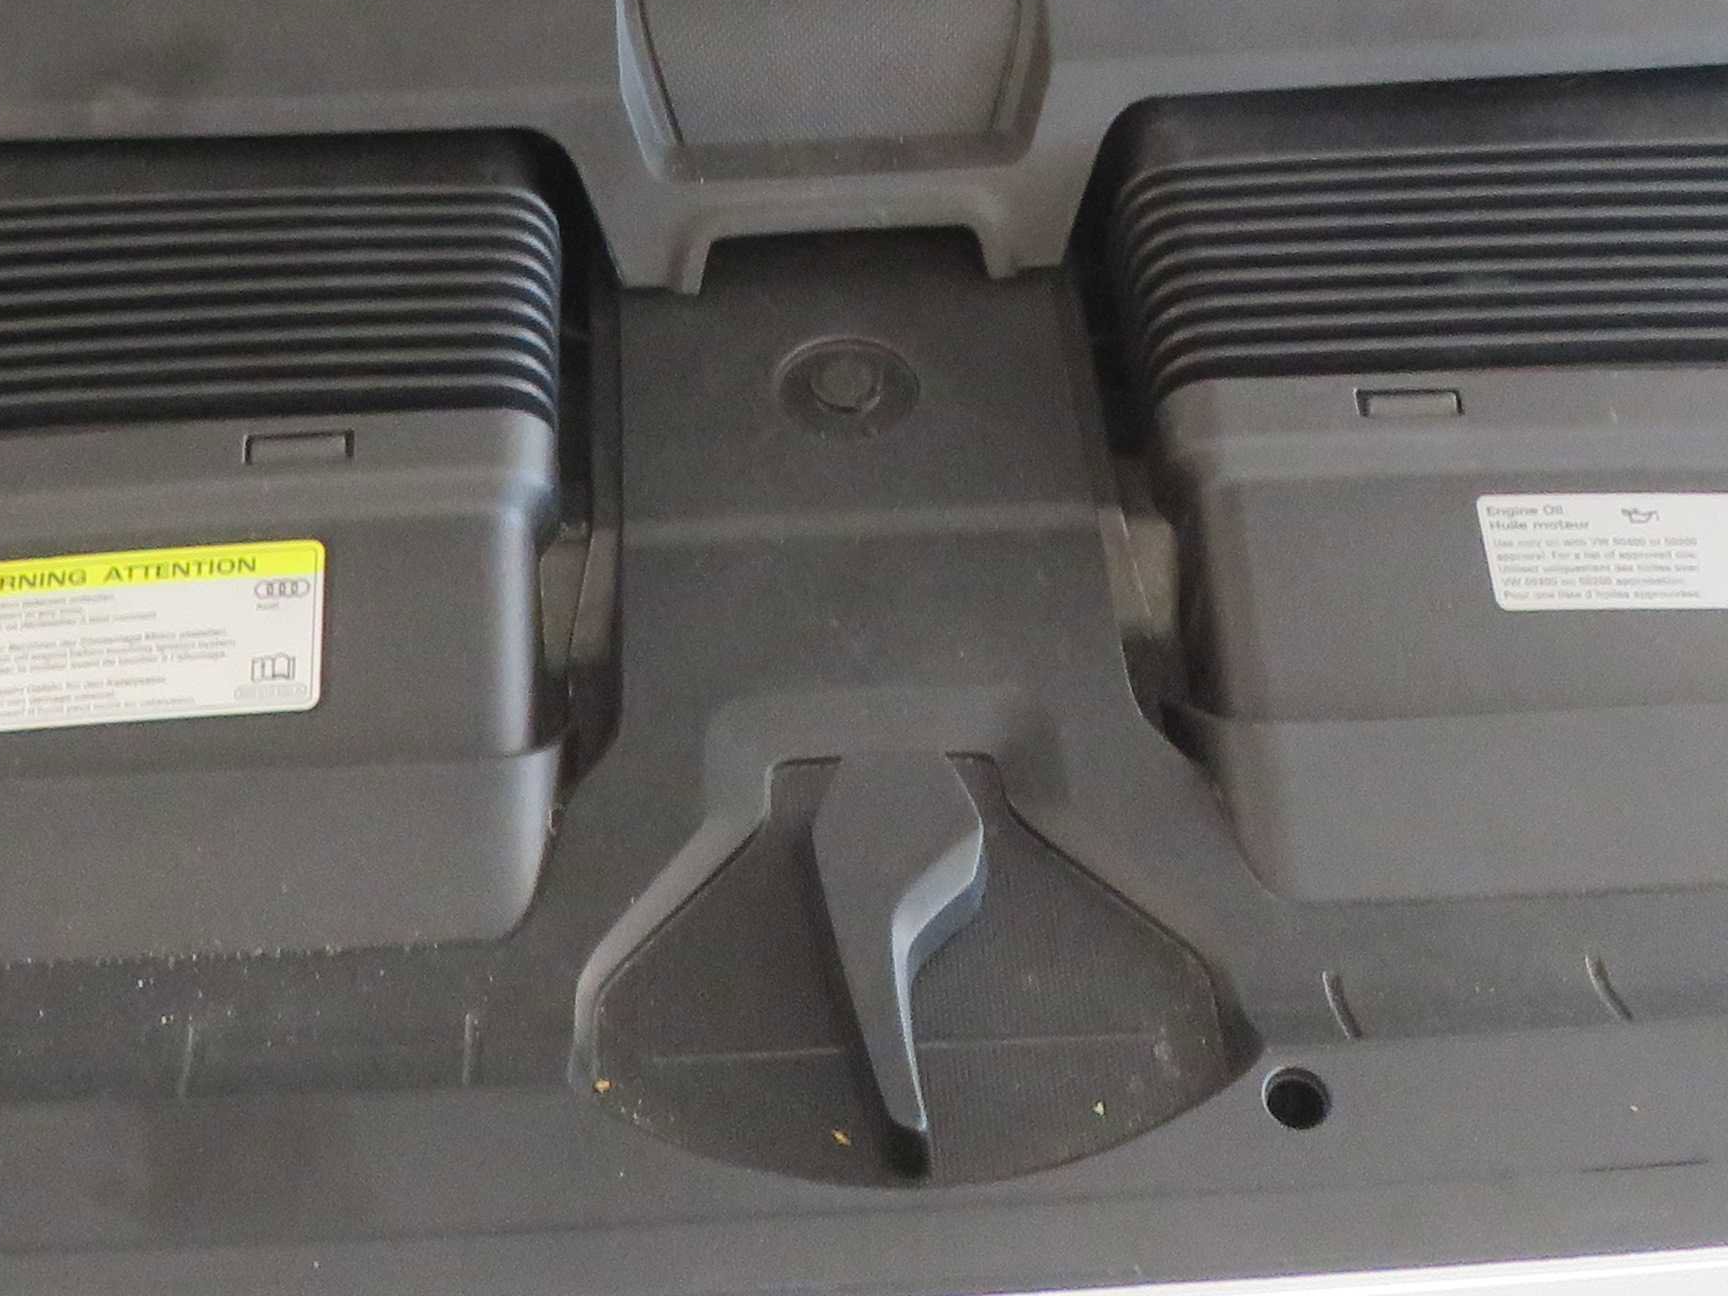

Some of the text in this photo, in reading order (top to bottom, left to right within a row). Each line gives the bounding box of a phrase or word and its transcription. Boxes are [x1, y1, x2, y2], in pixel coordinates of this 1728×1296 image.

[1486, 504, 1564, 518] Engine Oil
[1489, 519, 1590, 530] Huile moteur
[103, 557, 258, 583] ATTENTION
